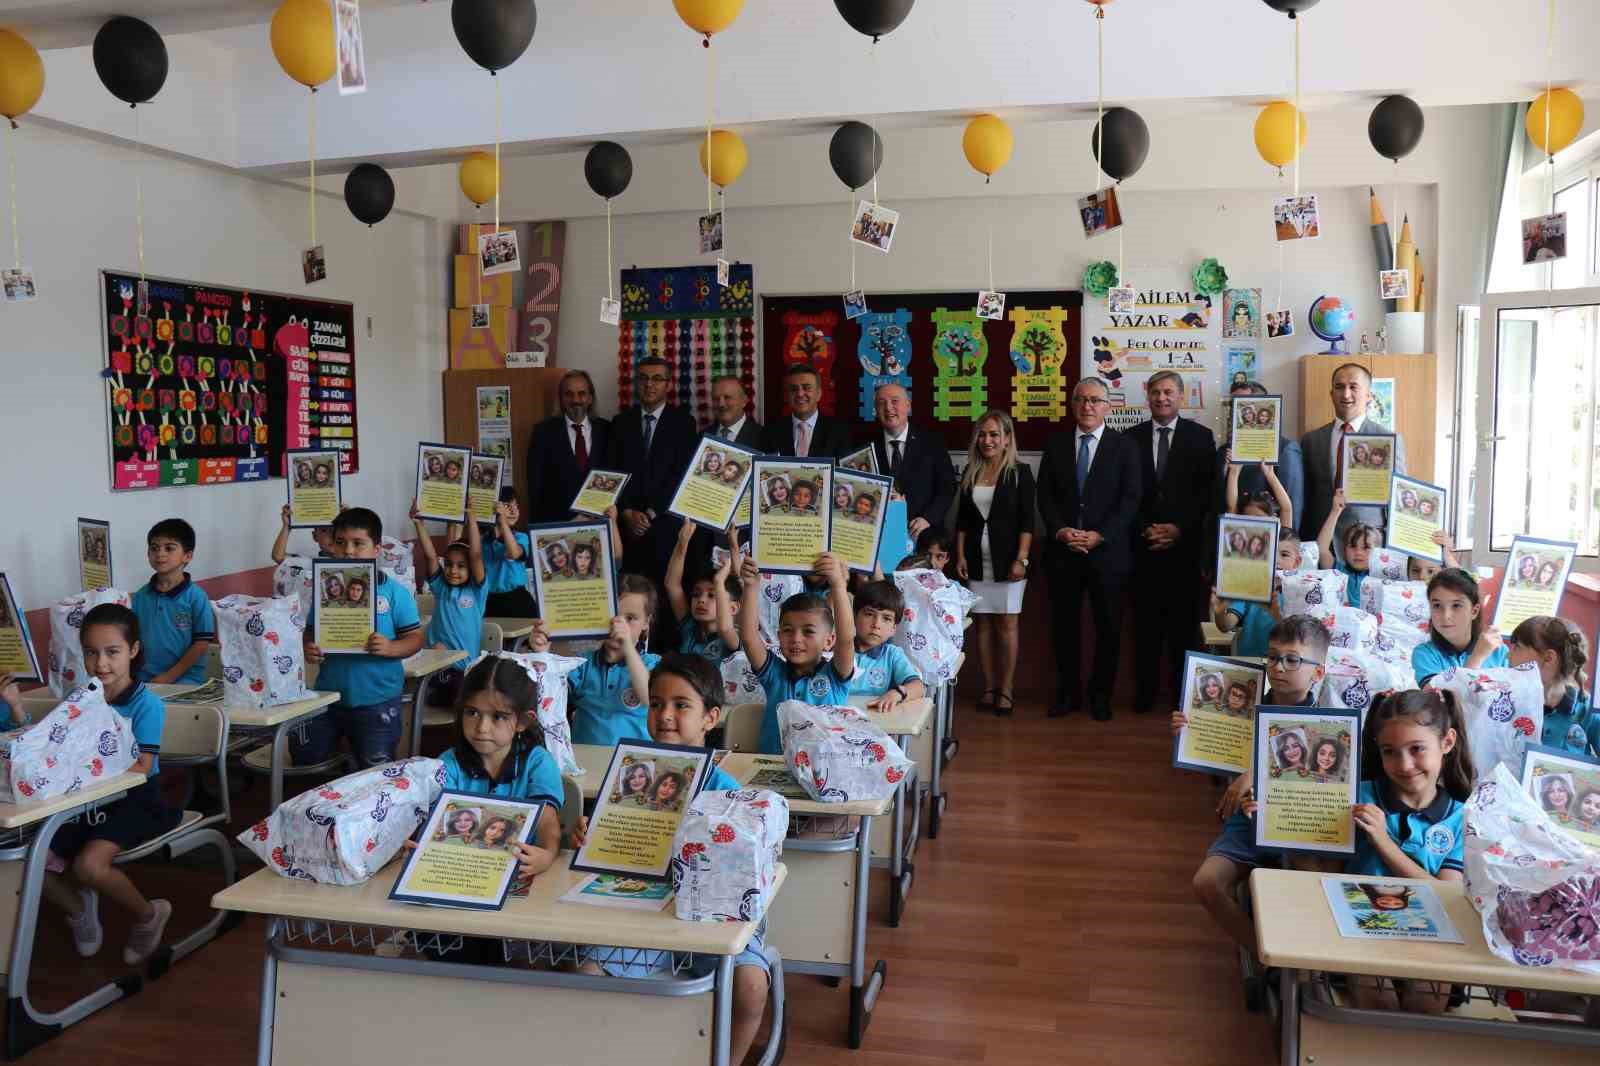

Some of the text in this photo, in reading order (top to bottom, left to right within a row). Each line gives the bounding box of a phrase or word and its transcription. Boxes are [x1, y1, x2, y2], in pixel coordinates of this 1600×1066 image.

[527, 262, 560, 312] 2
[1136, 290, 1191, 304] AİLEM
[313, 320, 342, 334] ZAMAN
[1109, 315, 1169, 328] YAZAR
